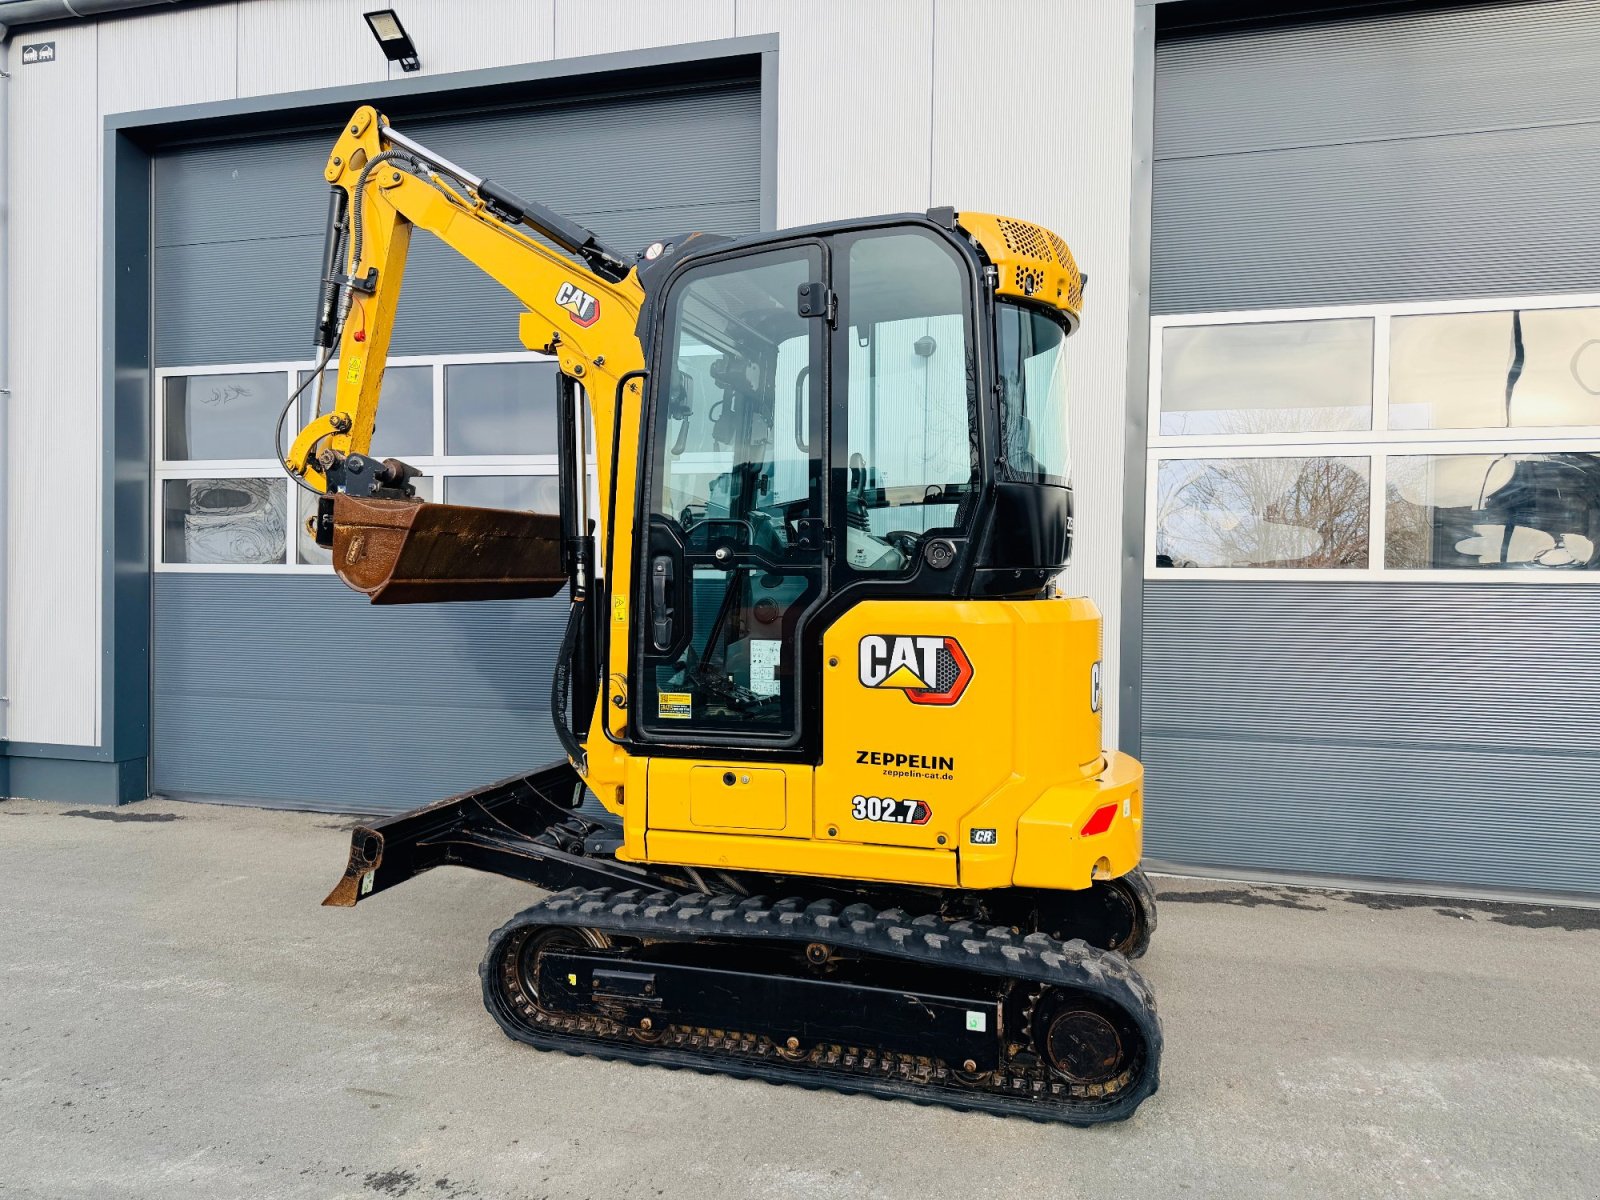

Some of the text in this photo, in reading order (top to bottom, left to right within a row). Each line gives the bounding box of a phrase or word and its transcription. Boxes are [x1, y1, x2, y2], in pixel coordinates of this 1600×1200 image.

[555, 281, 596, 318] CAT
[859, 635, 944, 689] CAT
[856, 750, 954, 771] ZEPPELIN
[882, 769, 954, 781] zeppelin-cat.de
[852, 795, 918, 824] 302.7
[974, 830, 993, 843] CR
